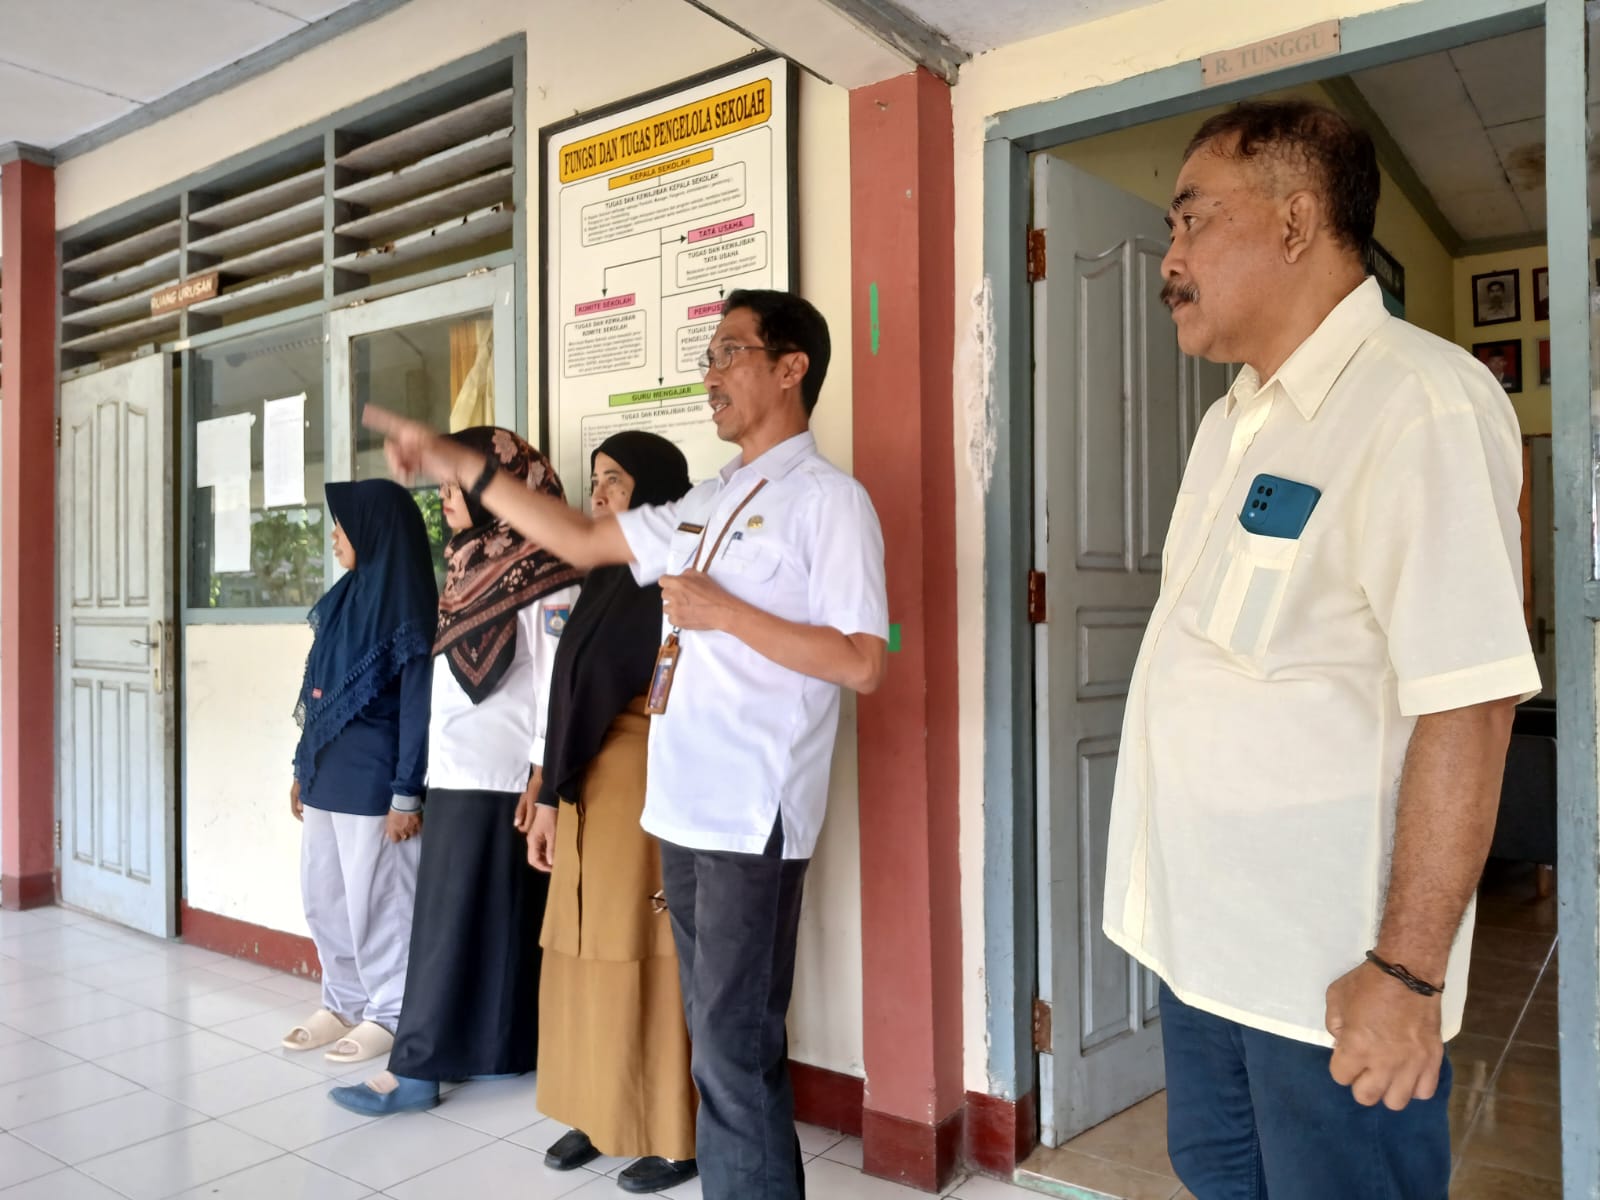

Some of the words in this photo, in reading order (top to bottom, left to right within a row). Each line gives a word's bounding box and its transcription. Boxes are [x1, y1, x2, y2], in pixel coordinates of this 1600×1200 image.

[1215, 57, 1233, 75] R.
[1237, 31, 1323, 69] TUNGGU
[564, 144, 597, 175] FUNGSI
[599, 136, 618, 164] DAN
[620, 129, 651, 158] TUGAS
[653, 112, 712, 147] PENGELOLA
[715, 88, 765, 128] SEKOLAH
[630, 167, 656, 181] KEPALA
[657, 158, 691, 174] SEKOLAH
[605, 199, 623, 209] TUGAS
[624, 196, 635, 204] DAN
[636, 186, 668, 201] KEWAJIBAN
[669, 180, 690, 192] KEPALA
[692, 172, 719, 186] SEKOLAH
[698, 227, 716, 238] TATA
[718, 220, 744, 233] USAHA
[688, 248, 707, 259] TUGAS
[708, 245, 720, 254] DAN
[721, 237, 755, 251] KEWAJIBAN
[704, 254, 717, 263] TATA
[719, 250, 739, 260] USAHA
[178, 276, 213, 301] URUSAN
[578, 303, 600, 313] KOMITE
[602, 297, 632, 308] SEKOLAH
[575, 321, 592, 330] TUGAS
[593, 319, 604, 327] DAN
[605, 314, 636, 325] KEWAJIBAN
[582, 328, 601, 336] KOMITE
[603, 324, 628, 333] SEKOLAH
[688, 325, 706, 334] TUGAS
[632, 392, 652, 401] GURU
[653, 387, 692, 399] MENGAJAR
[621, 412, 639, 420] TUGAS
[641, 410, 652, 418] DAN
[653, 407, 686, 416] KEWAJIBAN
[687, 404, 703, 413] GURU
